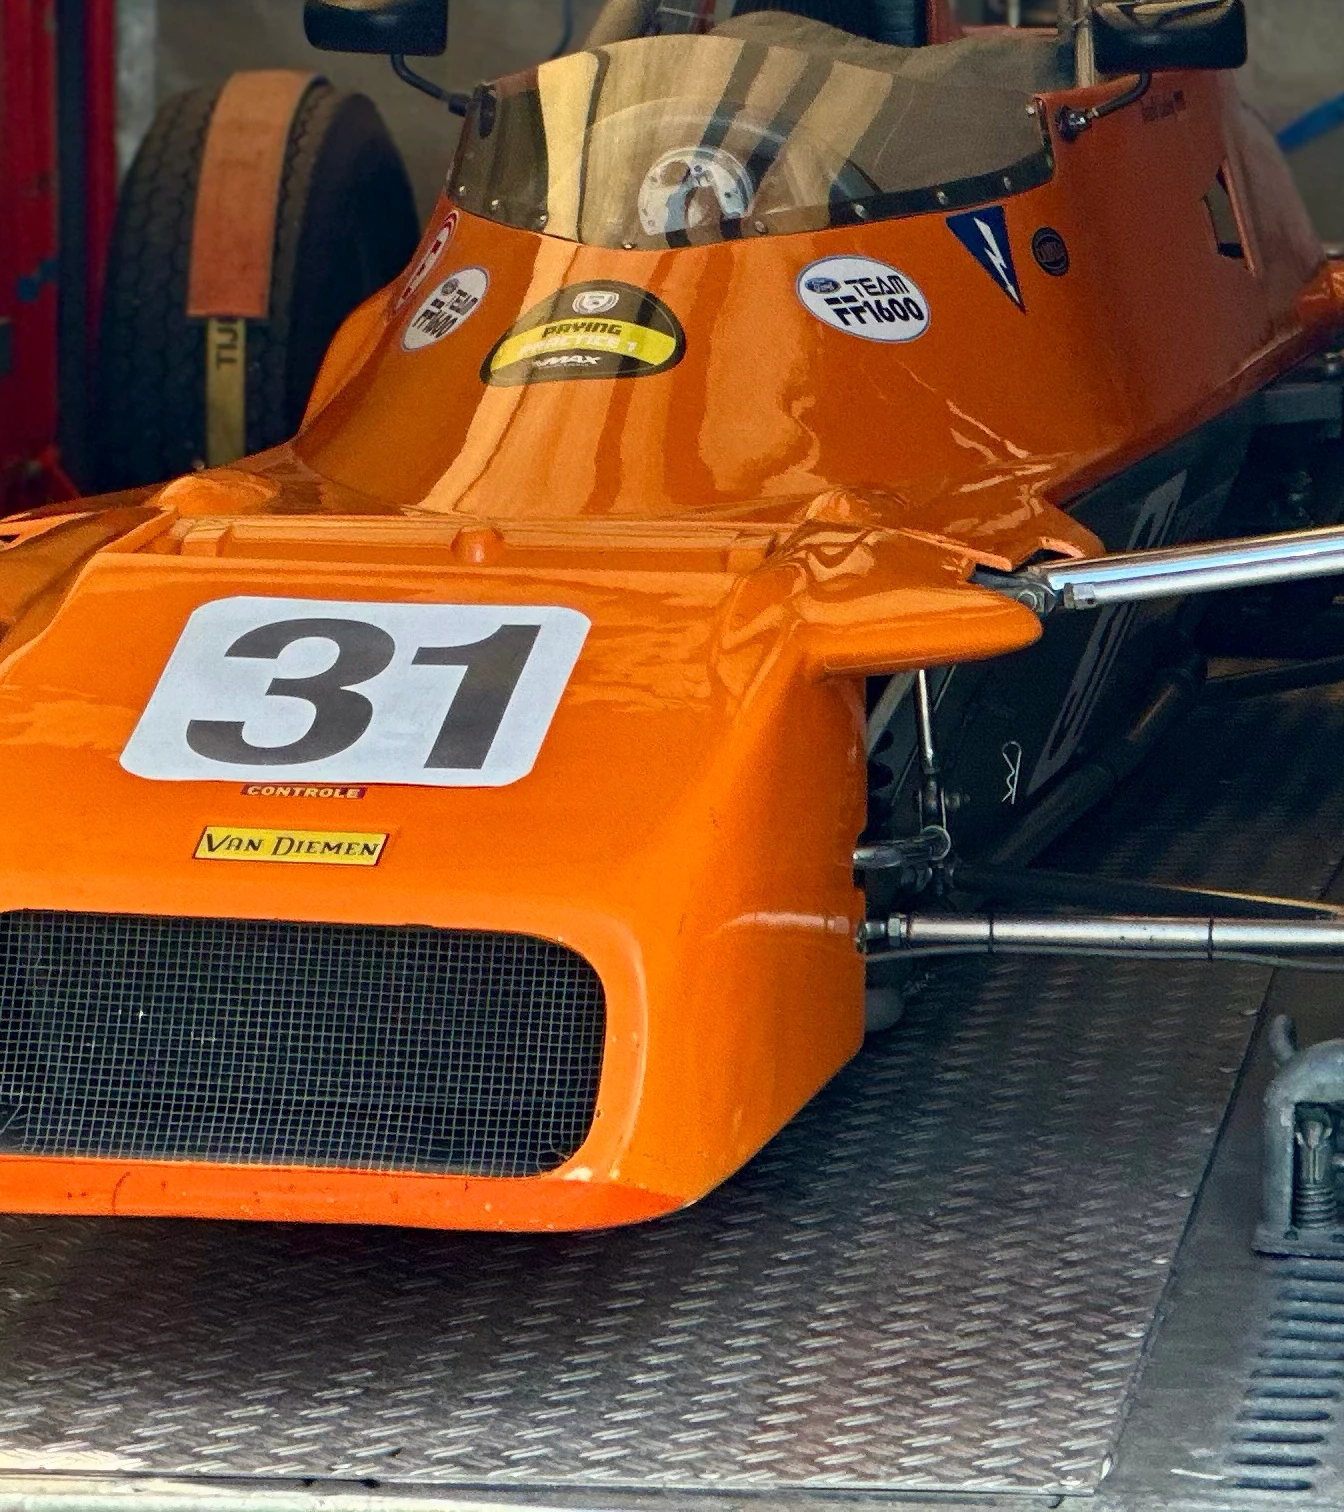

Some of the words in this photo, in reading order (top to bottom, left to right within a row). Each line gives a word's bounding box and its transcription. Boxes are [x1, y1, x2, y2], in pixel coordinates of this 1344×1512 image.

[844, 275, 911, 299] TEAM
[824, 295, 925, 326] FF1600
[216, 317, 238, 371] TIJ
[185, 616, 542, 771] 31
[245, 785, 362, 800] CONTROLE
